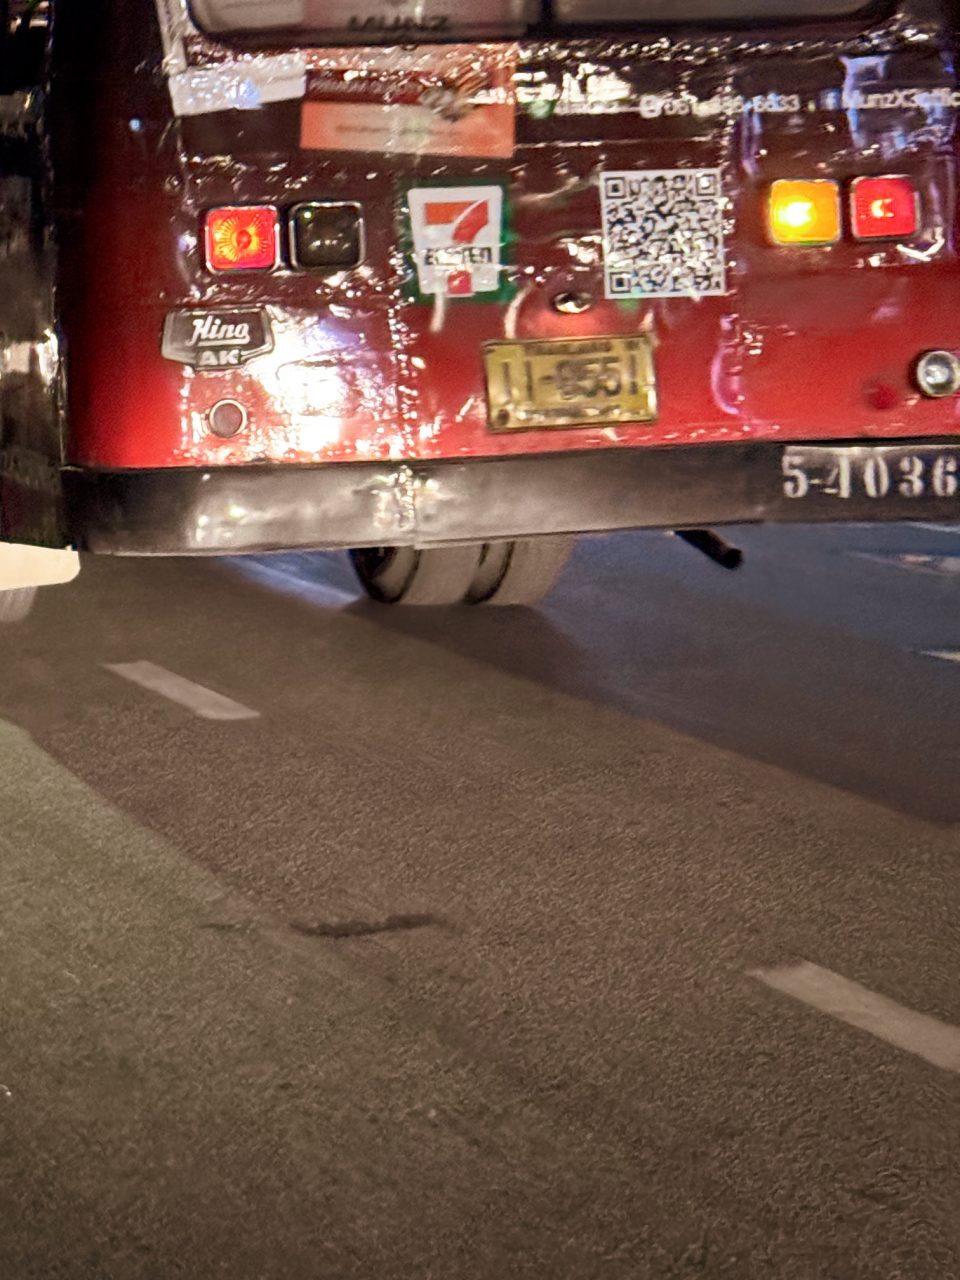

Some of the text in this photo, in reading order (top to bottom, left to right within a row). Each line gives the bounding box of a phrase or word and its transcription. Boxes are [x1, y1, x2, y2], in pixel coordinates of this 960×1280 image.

[185, 315, 250, 347] Hino
[201, 349, 240, 366] AK
[781, 453, 958, 499] 5-4036
